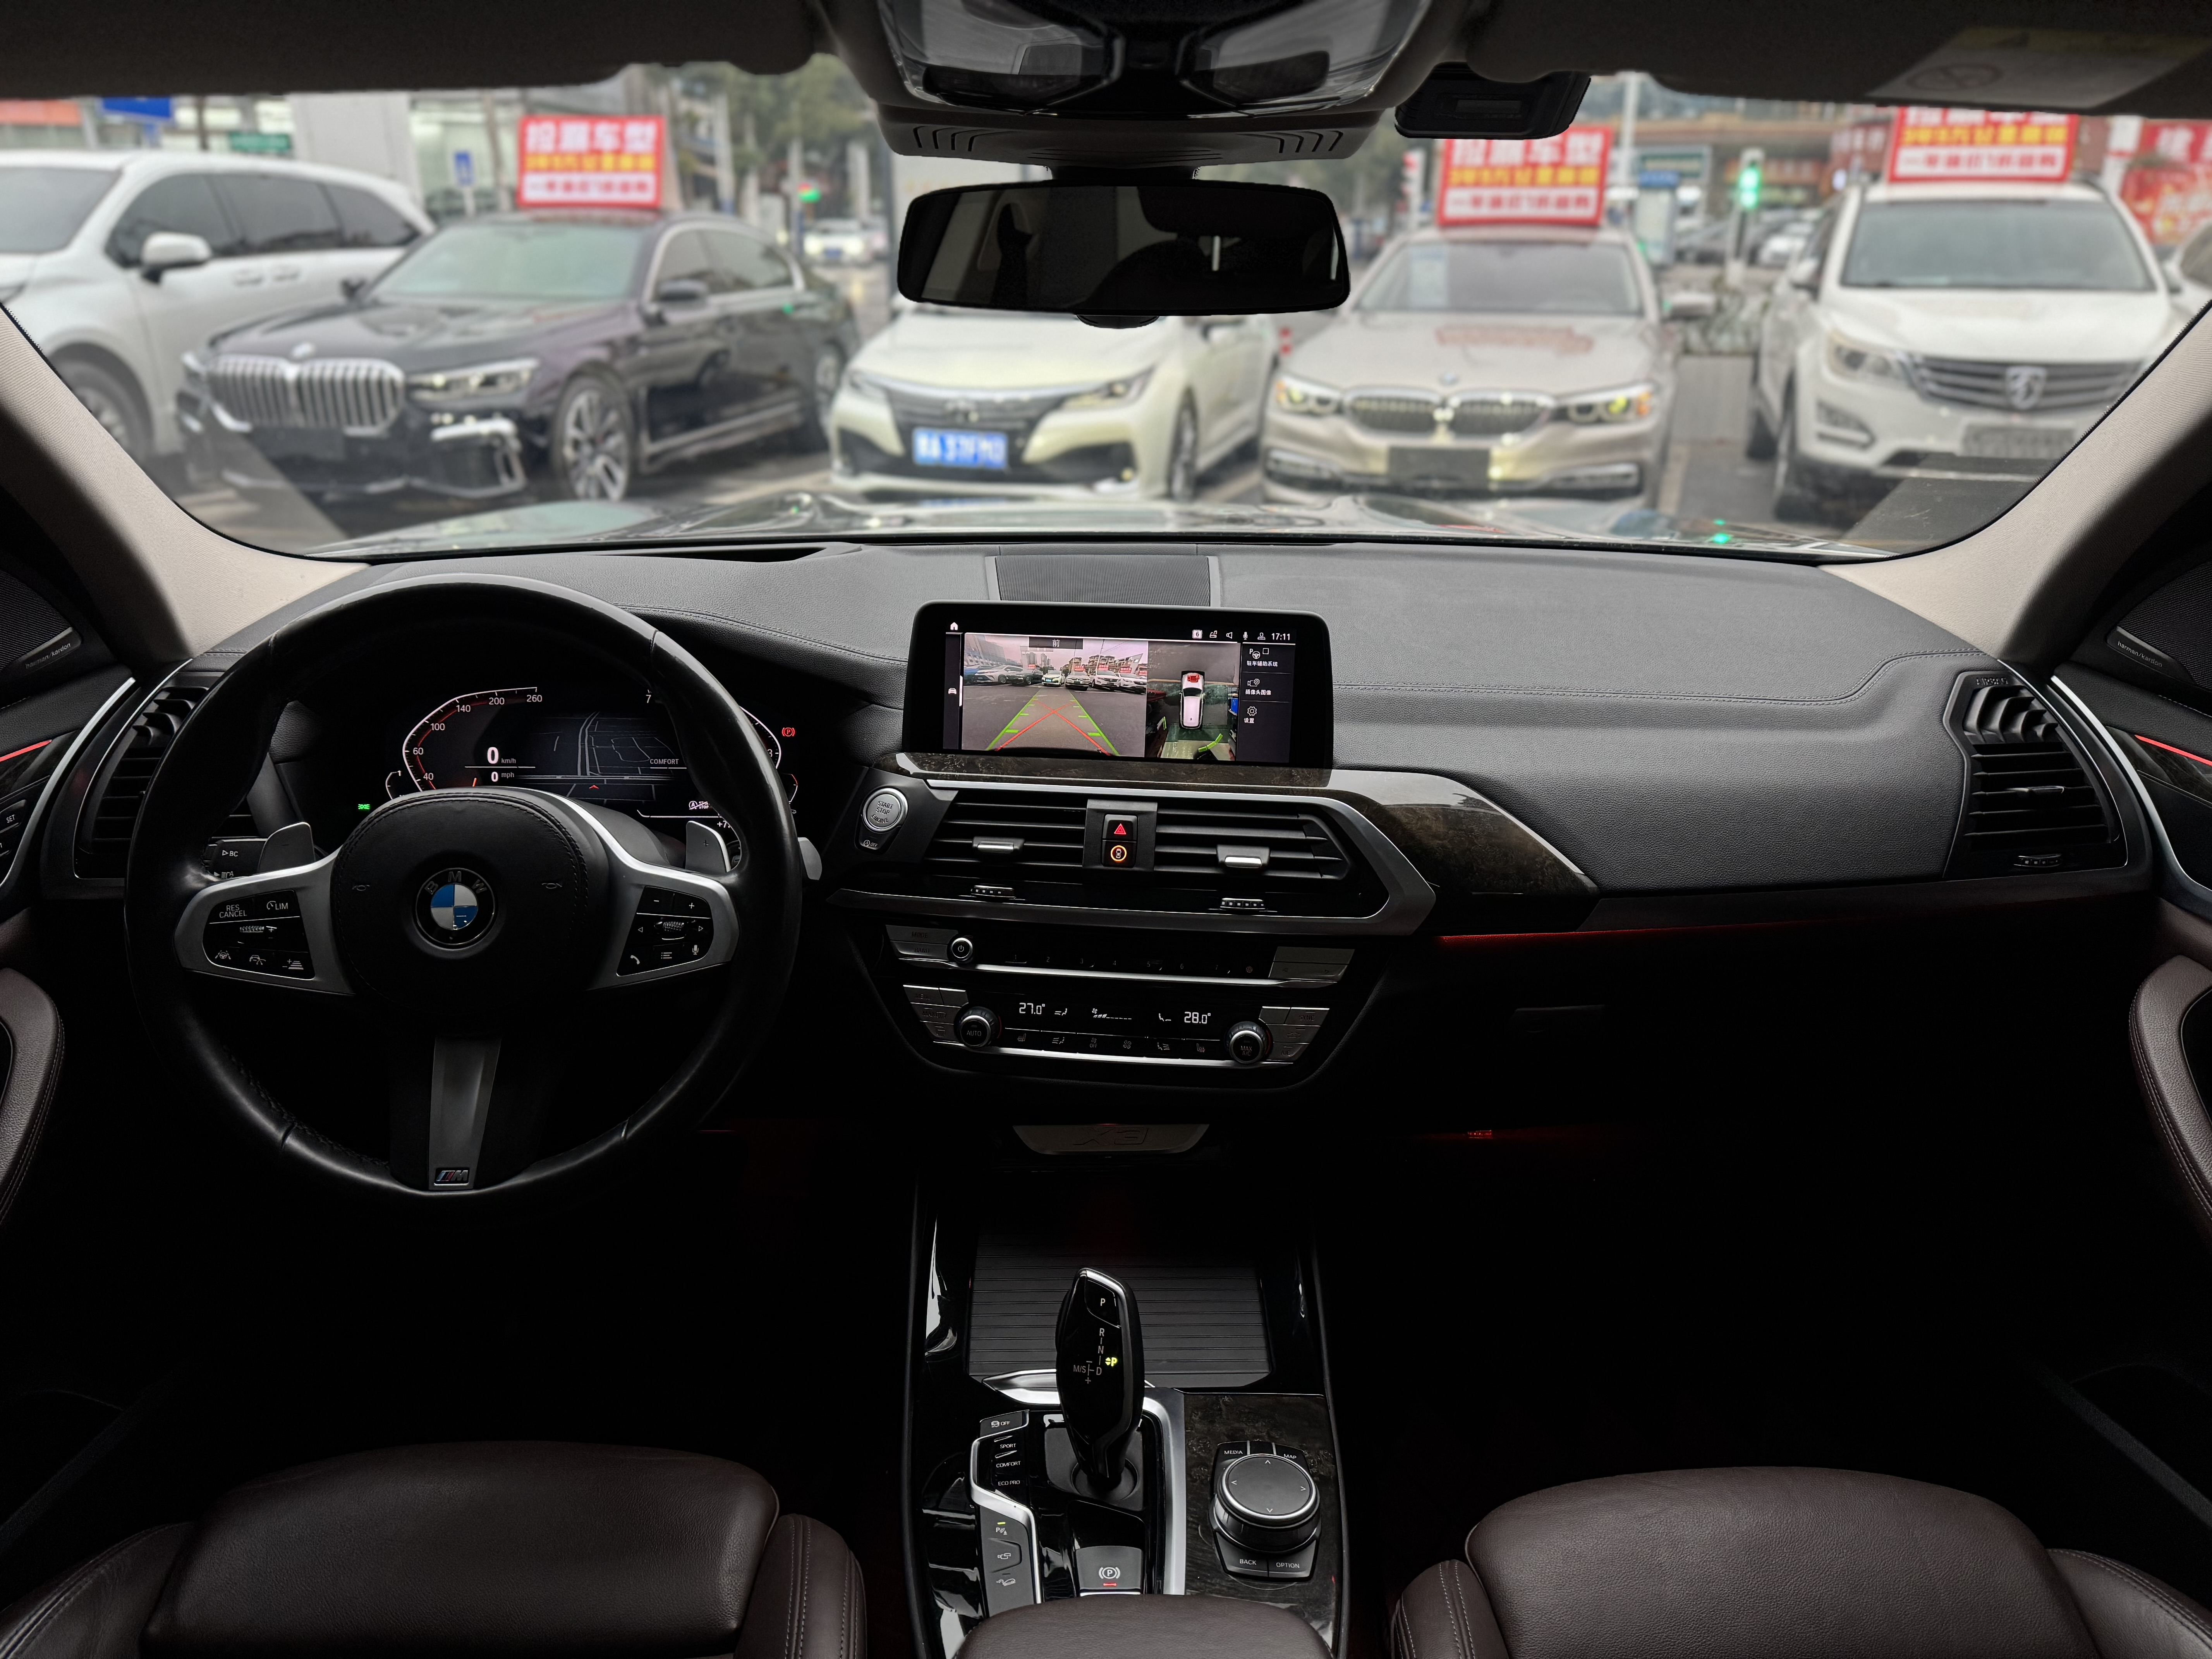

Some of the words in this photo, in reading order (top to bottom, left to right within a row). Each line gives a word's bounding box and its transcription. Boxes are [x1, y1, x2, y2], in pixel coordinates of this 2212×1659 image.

[1052, 639, 1060, 647] 前
[2118, 641, 2162, 667] harman/kardon
[646, 695, 651, 703] 7
[487, 747, 499, 764] 0
[491, 771, 499, 782] 0
[6, 814, 15, 823] SET
[871, 814, 888, 823] ENGINE
[424, 871, 487, 895] BMW
[219, 910, 247, 918] CANCEL
[1019, 1003, 1045, 1015] 27.0°
[1184, 1012, 1211, 1024] 28.0°
[1100, 1298, 1106, 1306] P
[1099, 1328, 1105, 1336] R
[1098, 1345, 1104, 1354] N
[1073, 1364, 1086, 1373] M/S
[1096, 1367, 1103, 1376] D
